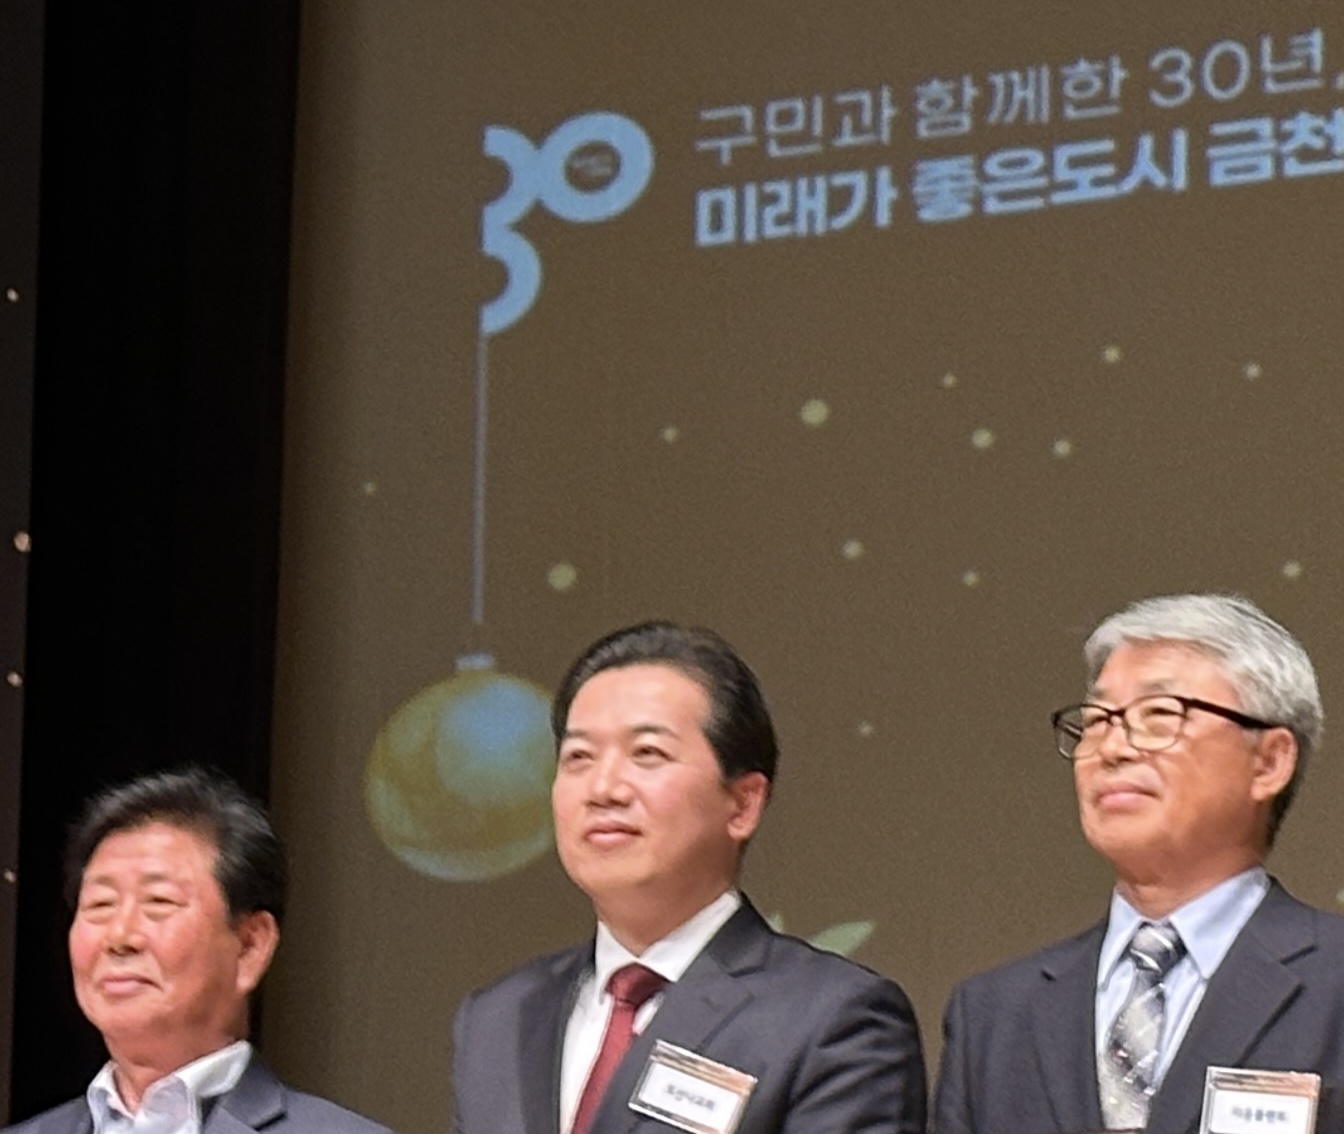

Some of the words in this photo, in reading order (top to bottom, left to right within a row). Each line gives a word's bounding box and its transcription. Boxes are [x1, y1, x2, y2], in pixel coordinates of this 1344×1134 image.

[696, 83, 898, 166] 구민과
[915, 53, 1129, 141] 함께한
[695, 164, 899, 247] 미래가
[913, 125, 1189, 223] 좋은도시
